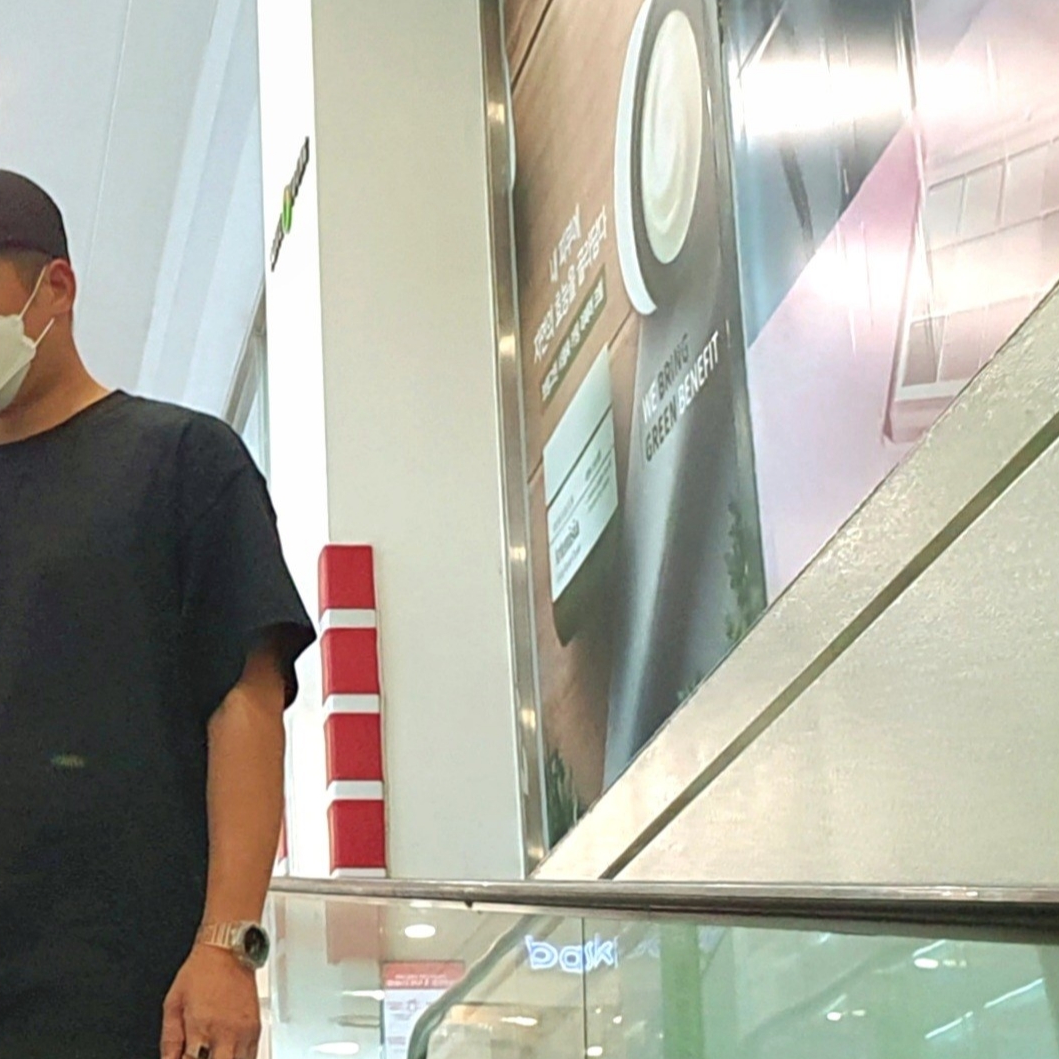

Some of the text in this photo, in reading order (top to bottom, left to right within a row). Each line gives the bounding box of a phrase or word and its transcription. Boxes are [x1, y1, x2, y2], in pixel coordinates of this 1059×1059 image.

[641, 333, 690, 424] WE BRING
[645, 330, 719, 462] GREEN BENEFIT
